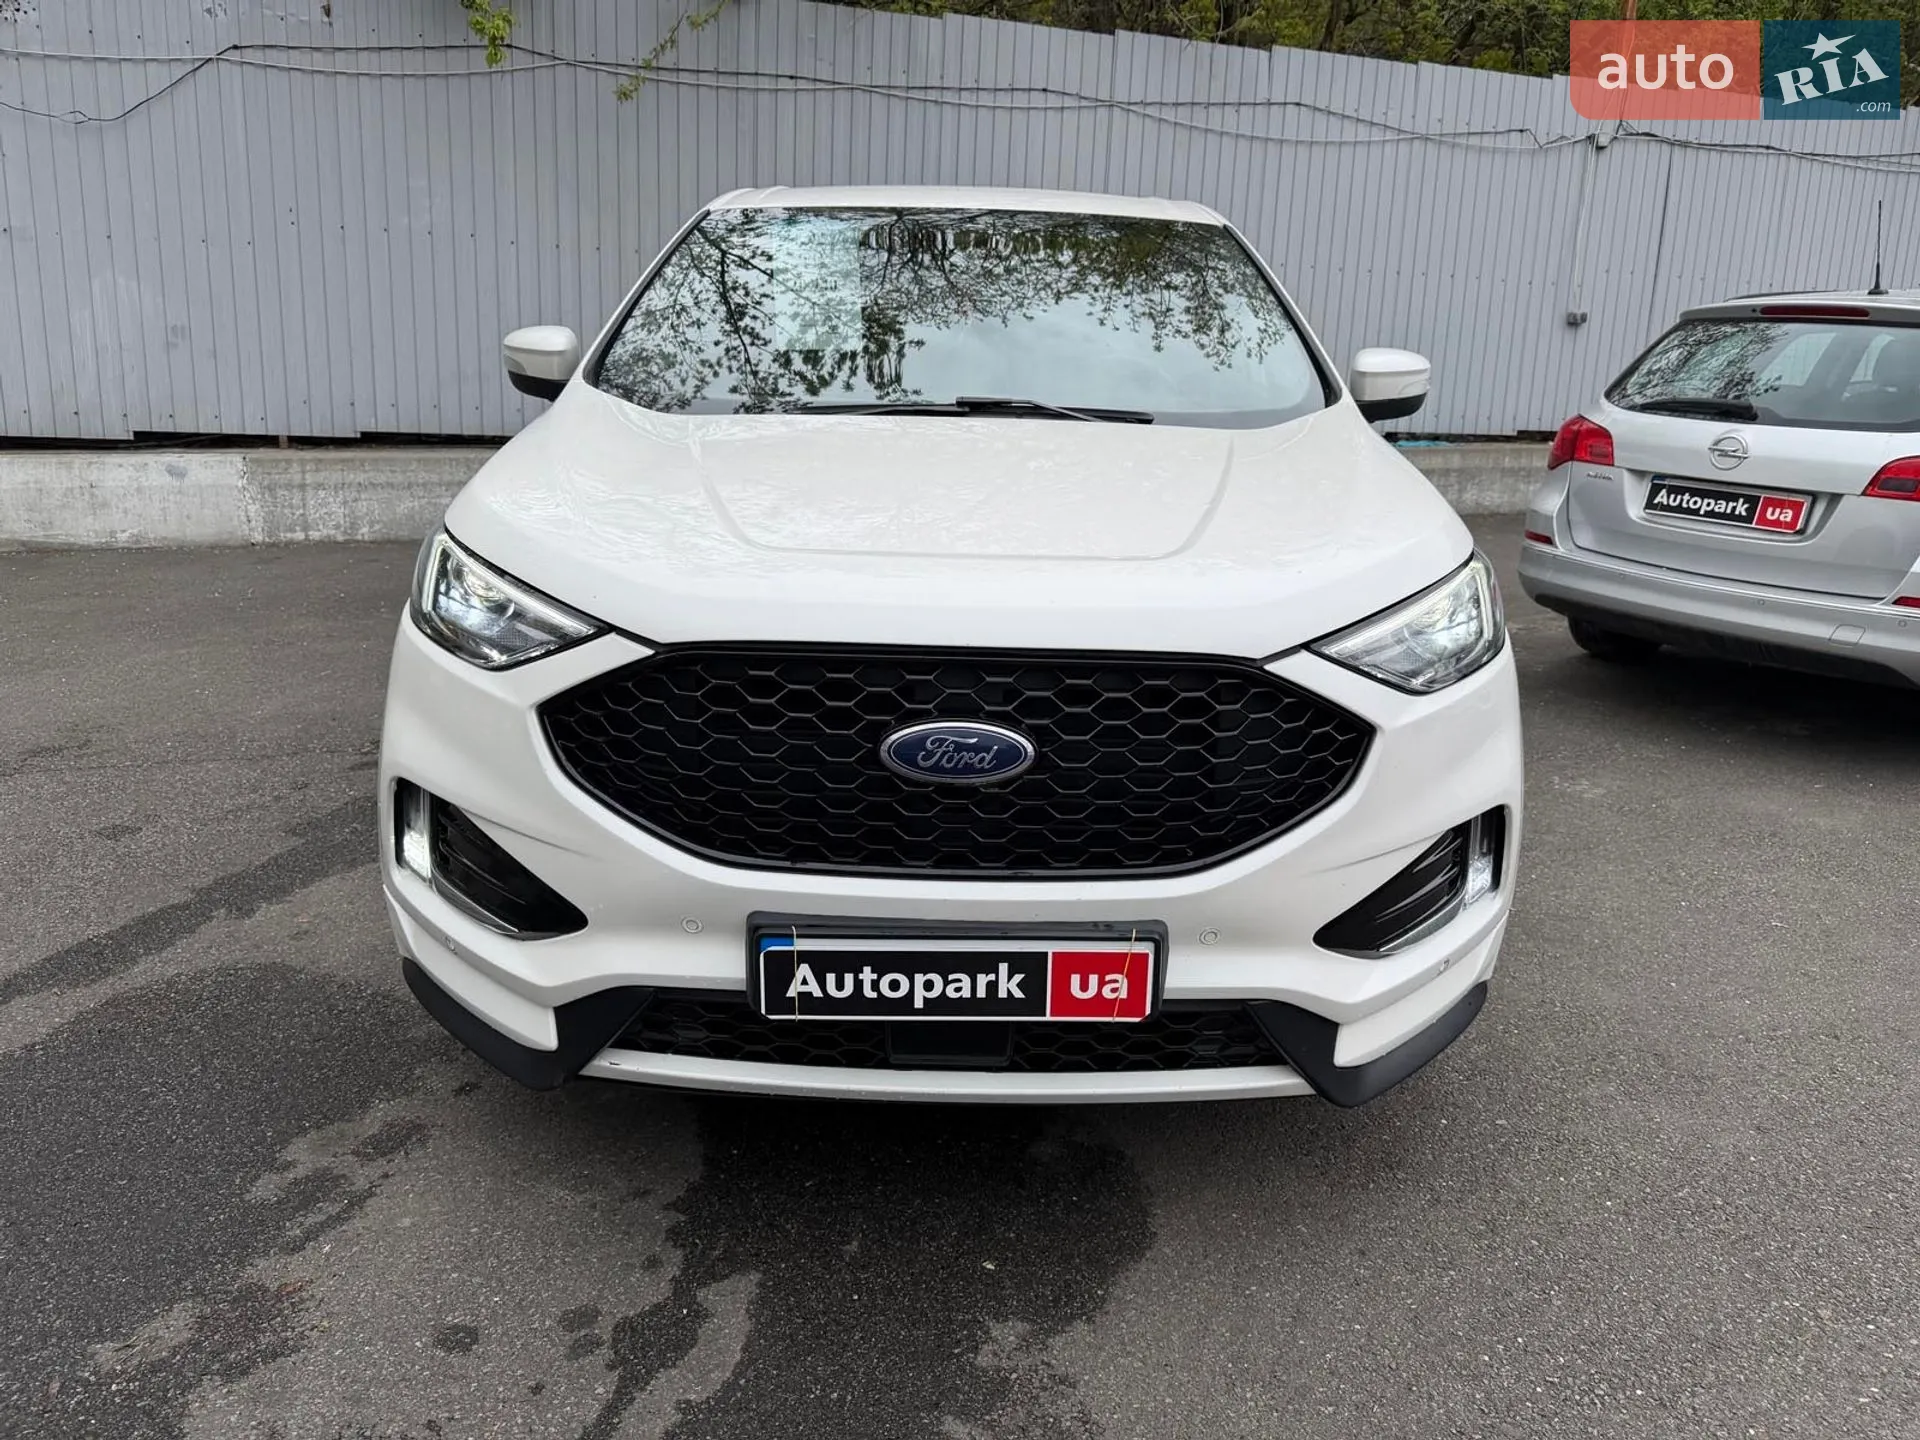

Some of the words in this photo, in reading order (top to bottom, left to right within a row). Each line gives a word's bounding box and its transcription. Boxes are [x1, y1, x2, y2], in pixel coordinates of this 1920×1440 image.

[1653, 488, 1750, 517] Autopark
[1765, 506, 1794, 522] ua
[916, 735, 999, 769] Ford
[785, 963, 1026, 1008] Autopark
[1070, 973, 1129, 999] ua
